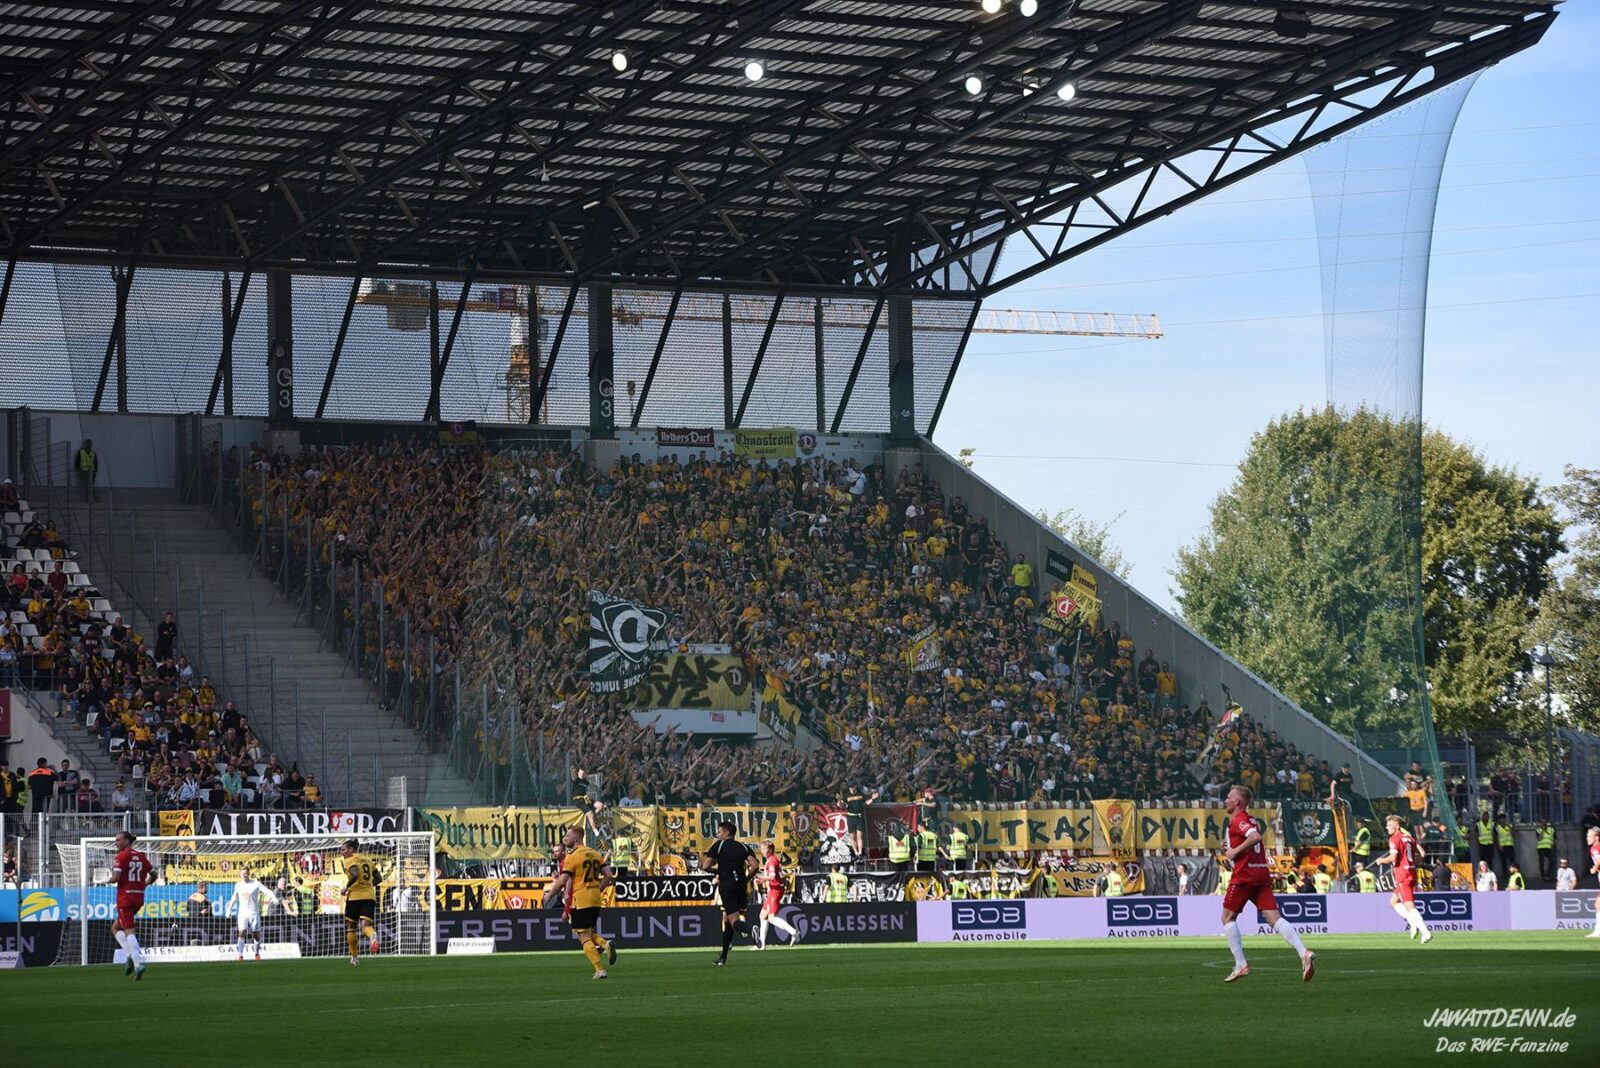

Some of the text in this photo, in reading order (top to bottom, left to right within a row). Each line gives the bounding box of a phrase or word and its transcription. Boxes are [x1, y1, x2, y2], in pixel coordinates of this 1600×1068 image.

[601, 400, 612, 417] 3
[206, 812, 398, 847] ALTENBRG
[962, 816, 1091, 847] ULTRAS
[128, 861, 143, 882] 27
[362, 863, 371, 881] 9
[615, 879, 714, 900] DYNAMO
[957, 906, 1021, 925] BOB
[1112, 903, 1175, 921] BOB
[1281, 901, 1322, 918] OB
[811, 914, 904, 933] SALESSEN
[1108, 927, 1180, 938] Automobile
[1258, 924, 1328, 935] Auobile
[1405, 922, 1473, 932] Aomobile
[953, 931, 1027, 942] Automobile
